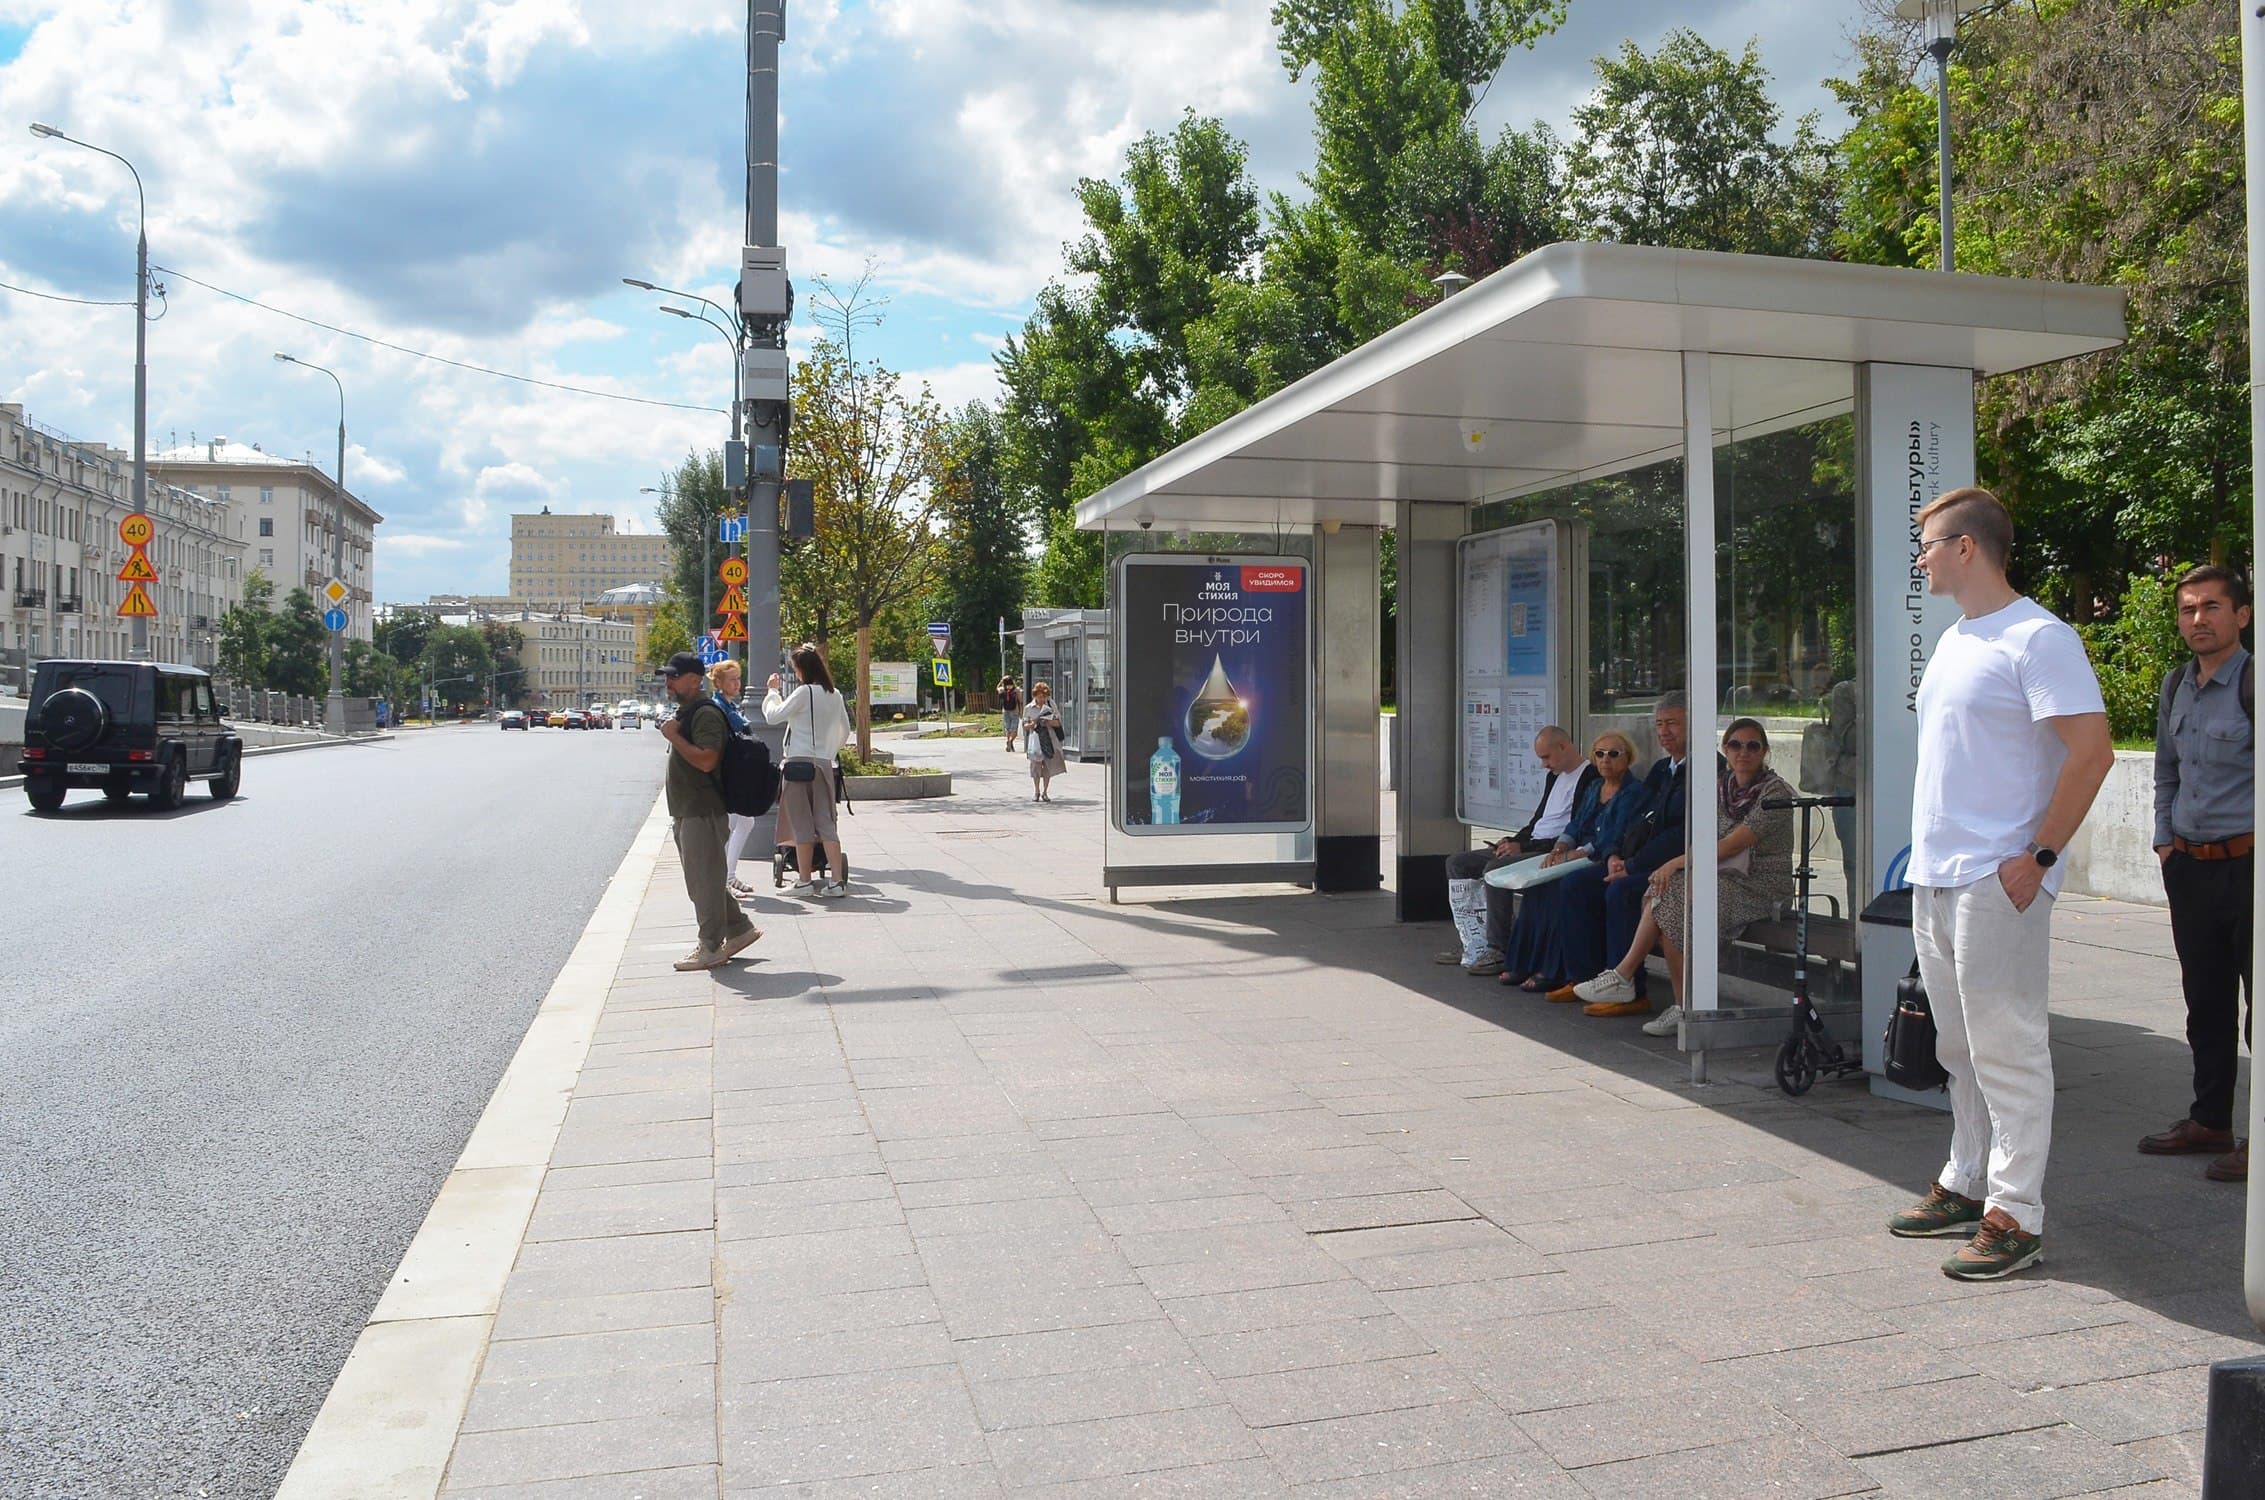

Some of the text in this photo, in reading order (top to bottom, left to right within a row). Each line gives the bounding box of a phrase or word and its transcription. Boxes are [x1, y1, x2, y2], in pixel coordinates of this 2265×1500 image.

[1928, 421, 1942, 476] Kultury
[126, 523, 146, 537] 40
[726, 566, 742, 578] 40
[1206, 582, 1230, 591] МОЯ
[1906, 552, 1926, 625] «Парк
[1198, 592, 1238, 600] СТИХИЯ
[1162, 603, 1272, 624] Природа
[1175, 627, 1261, 647] внутри
[1189, 774, 1247, 782] моястихия.рф
